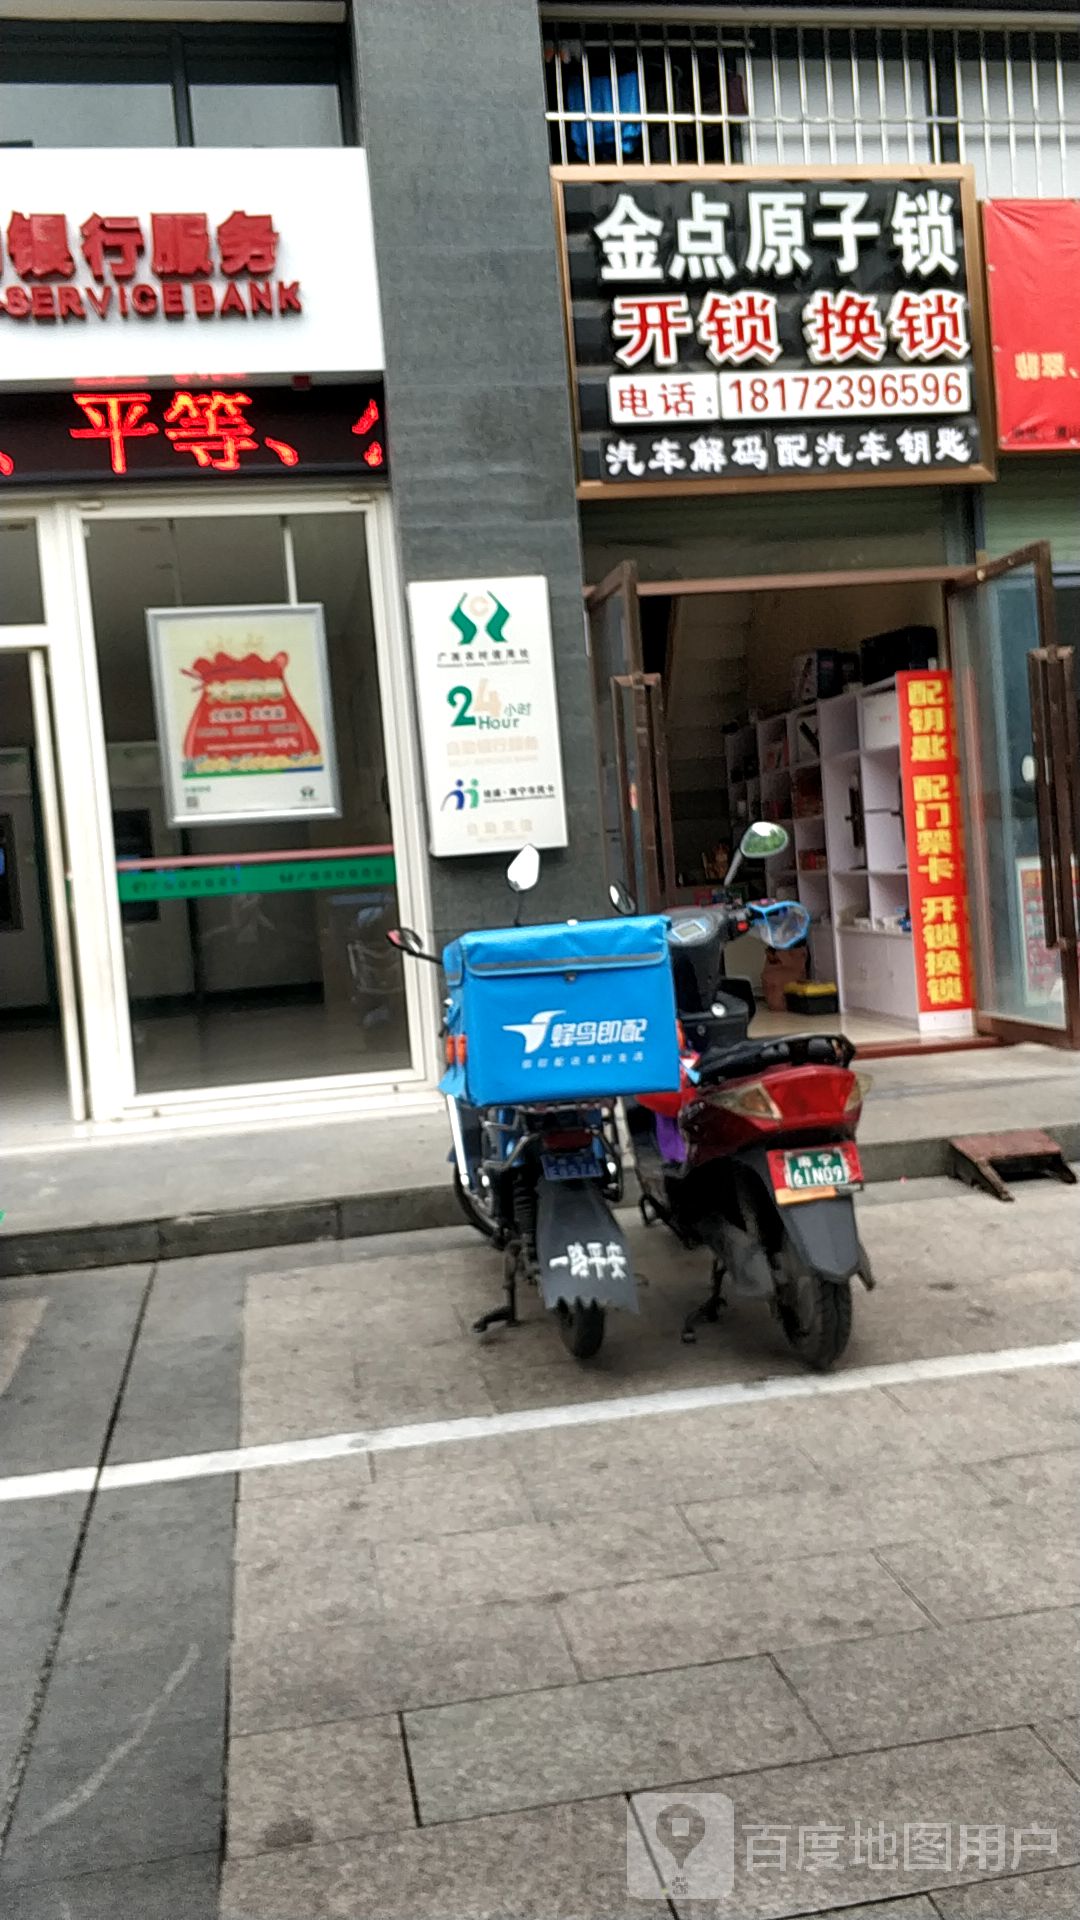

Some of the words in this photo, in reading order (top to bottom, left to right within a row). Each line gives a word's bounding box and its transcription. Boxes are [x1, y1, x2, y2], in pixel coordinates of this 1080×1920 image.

[0, 210, 280, 280] 银行服务
[595, 189, 960, 281] 金点原子锁
[613, 290, 782, 368] 开锁
[805, 289, 971, 363] 换锁
[617, 382, 714, 419] 电话:
[728, 371, 963, 413] 18172396596
[605, 427, 973, 477] 汽车解码配汽车钥匙
[478, 716, 520, 730] Hour
[907, 679, 948, 762] 配钥匙
[920, 895, 964, 1005] 开锁换锁
[550, 1018, 648, 1048] 蜂鸟即配
[550, 1242, 627, 1280] 一路平安
